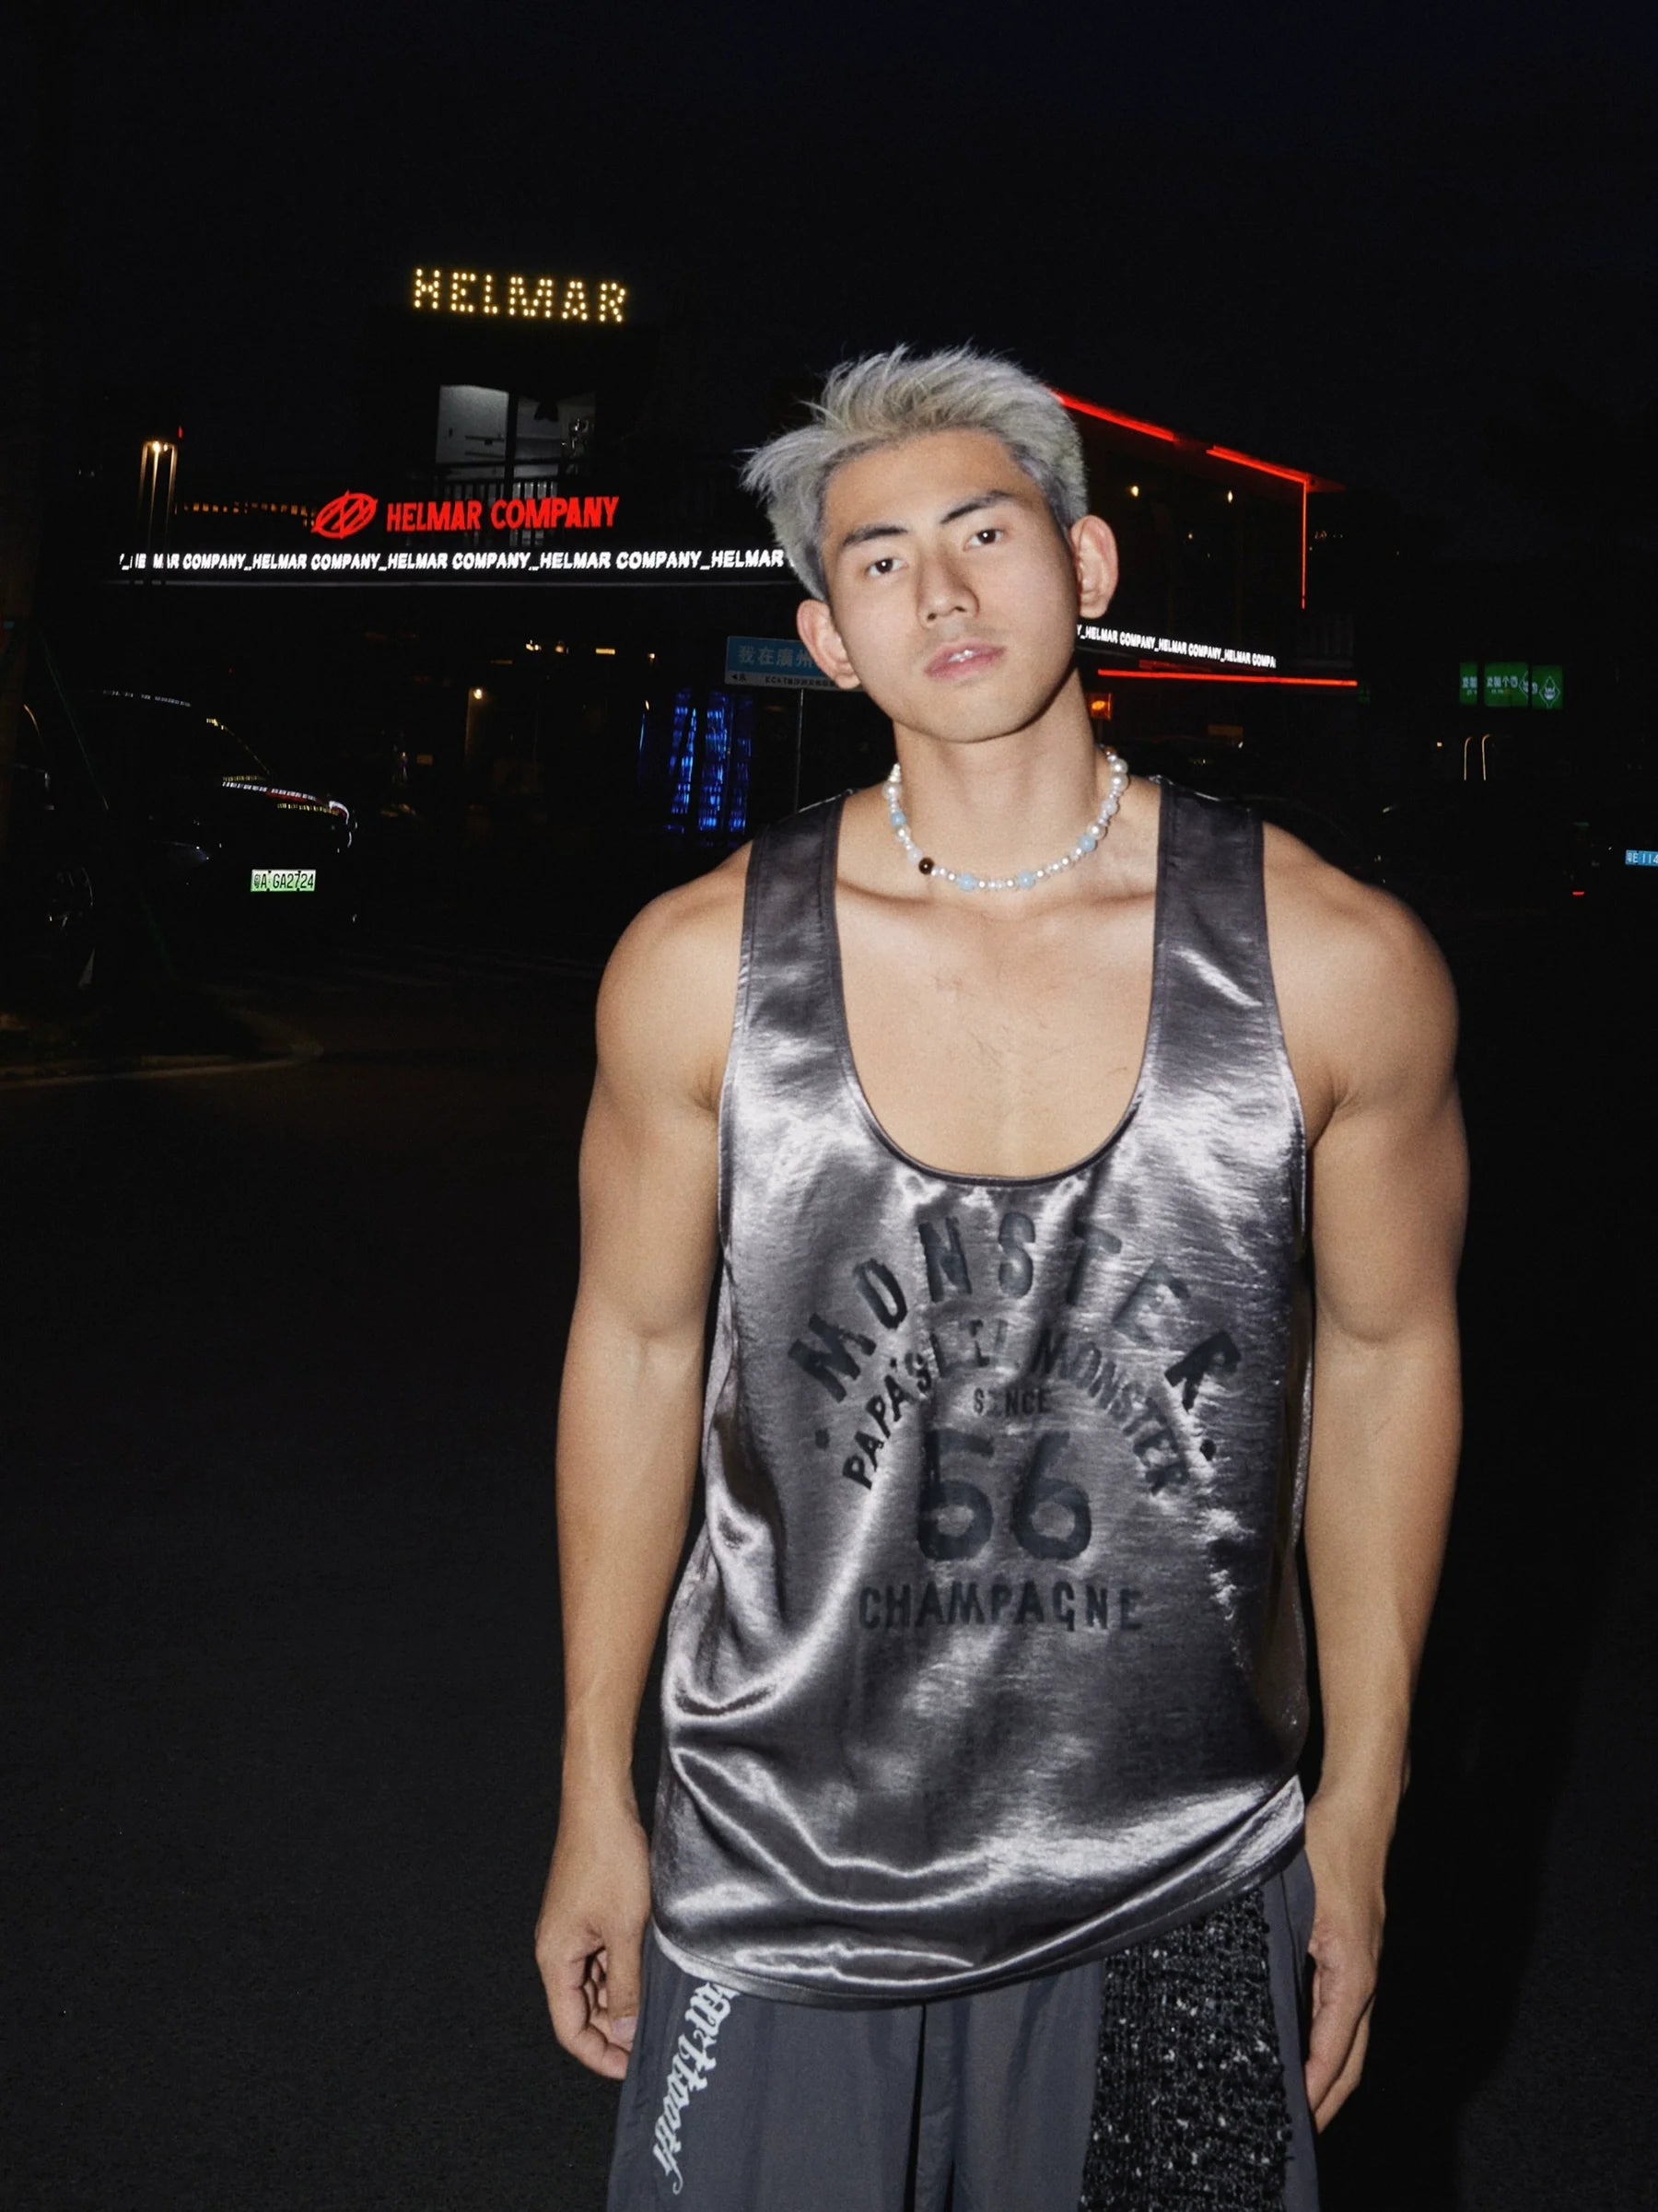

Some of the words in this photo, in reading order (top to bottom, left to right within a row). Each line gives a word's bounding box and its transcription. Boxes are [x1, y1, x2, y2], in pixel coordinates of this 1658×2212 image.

[414, 268, 626, 322] HELMAR
[387, 500, 483, 532] HELMAR
[491, 497, 620, 530] COMPANY
[918, 1430, 1092, 1561] 56
[859, 1580, 1145, 1632] CHAMPAGNE
